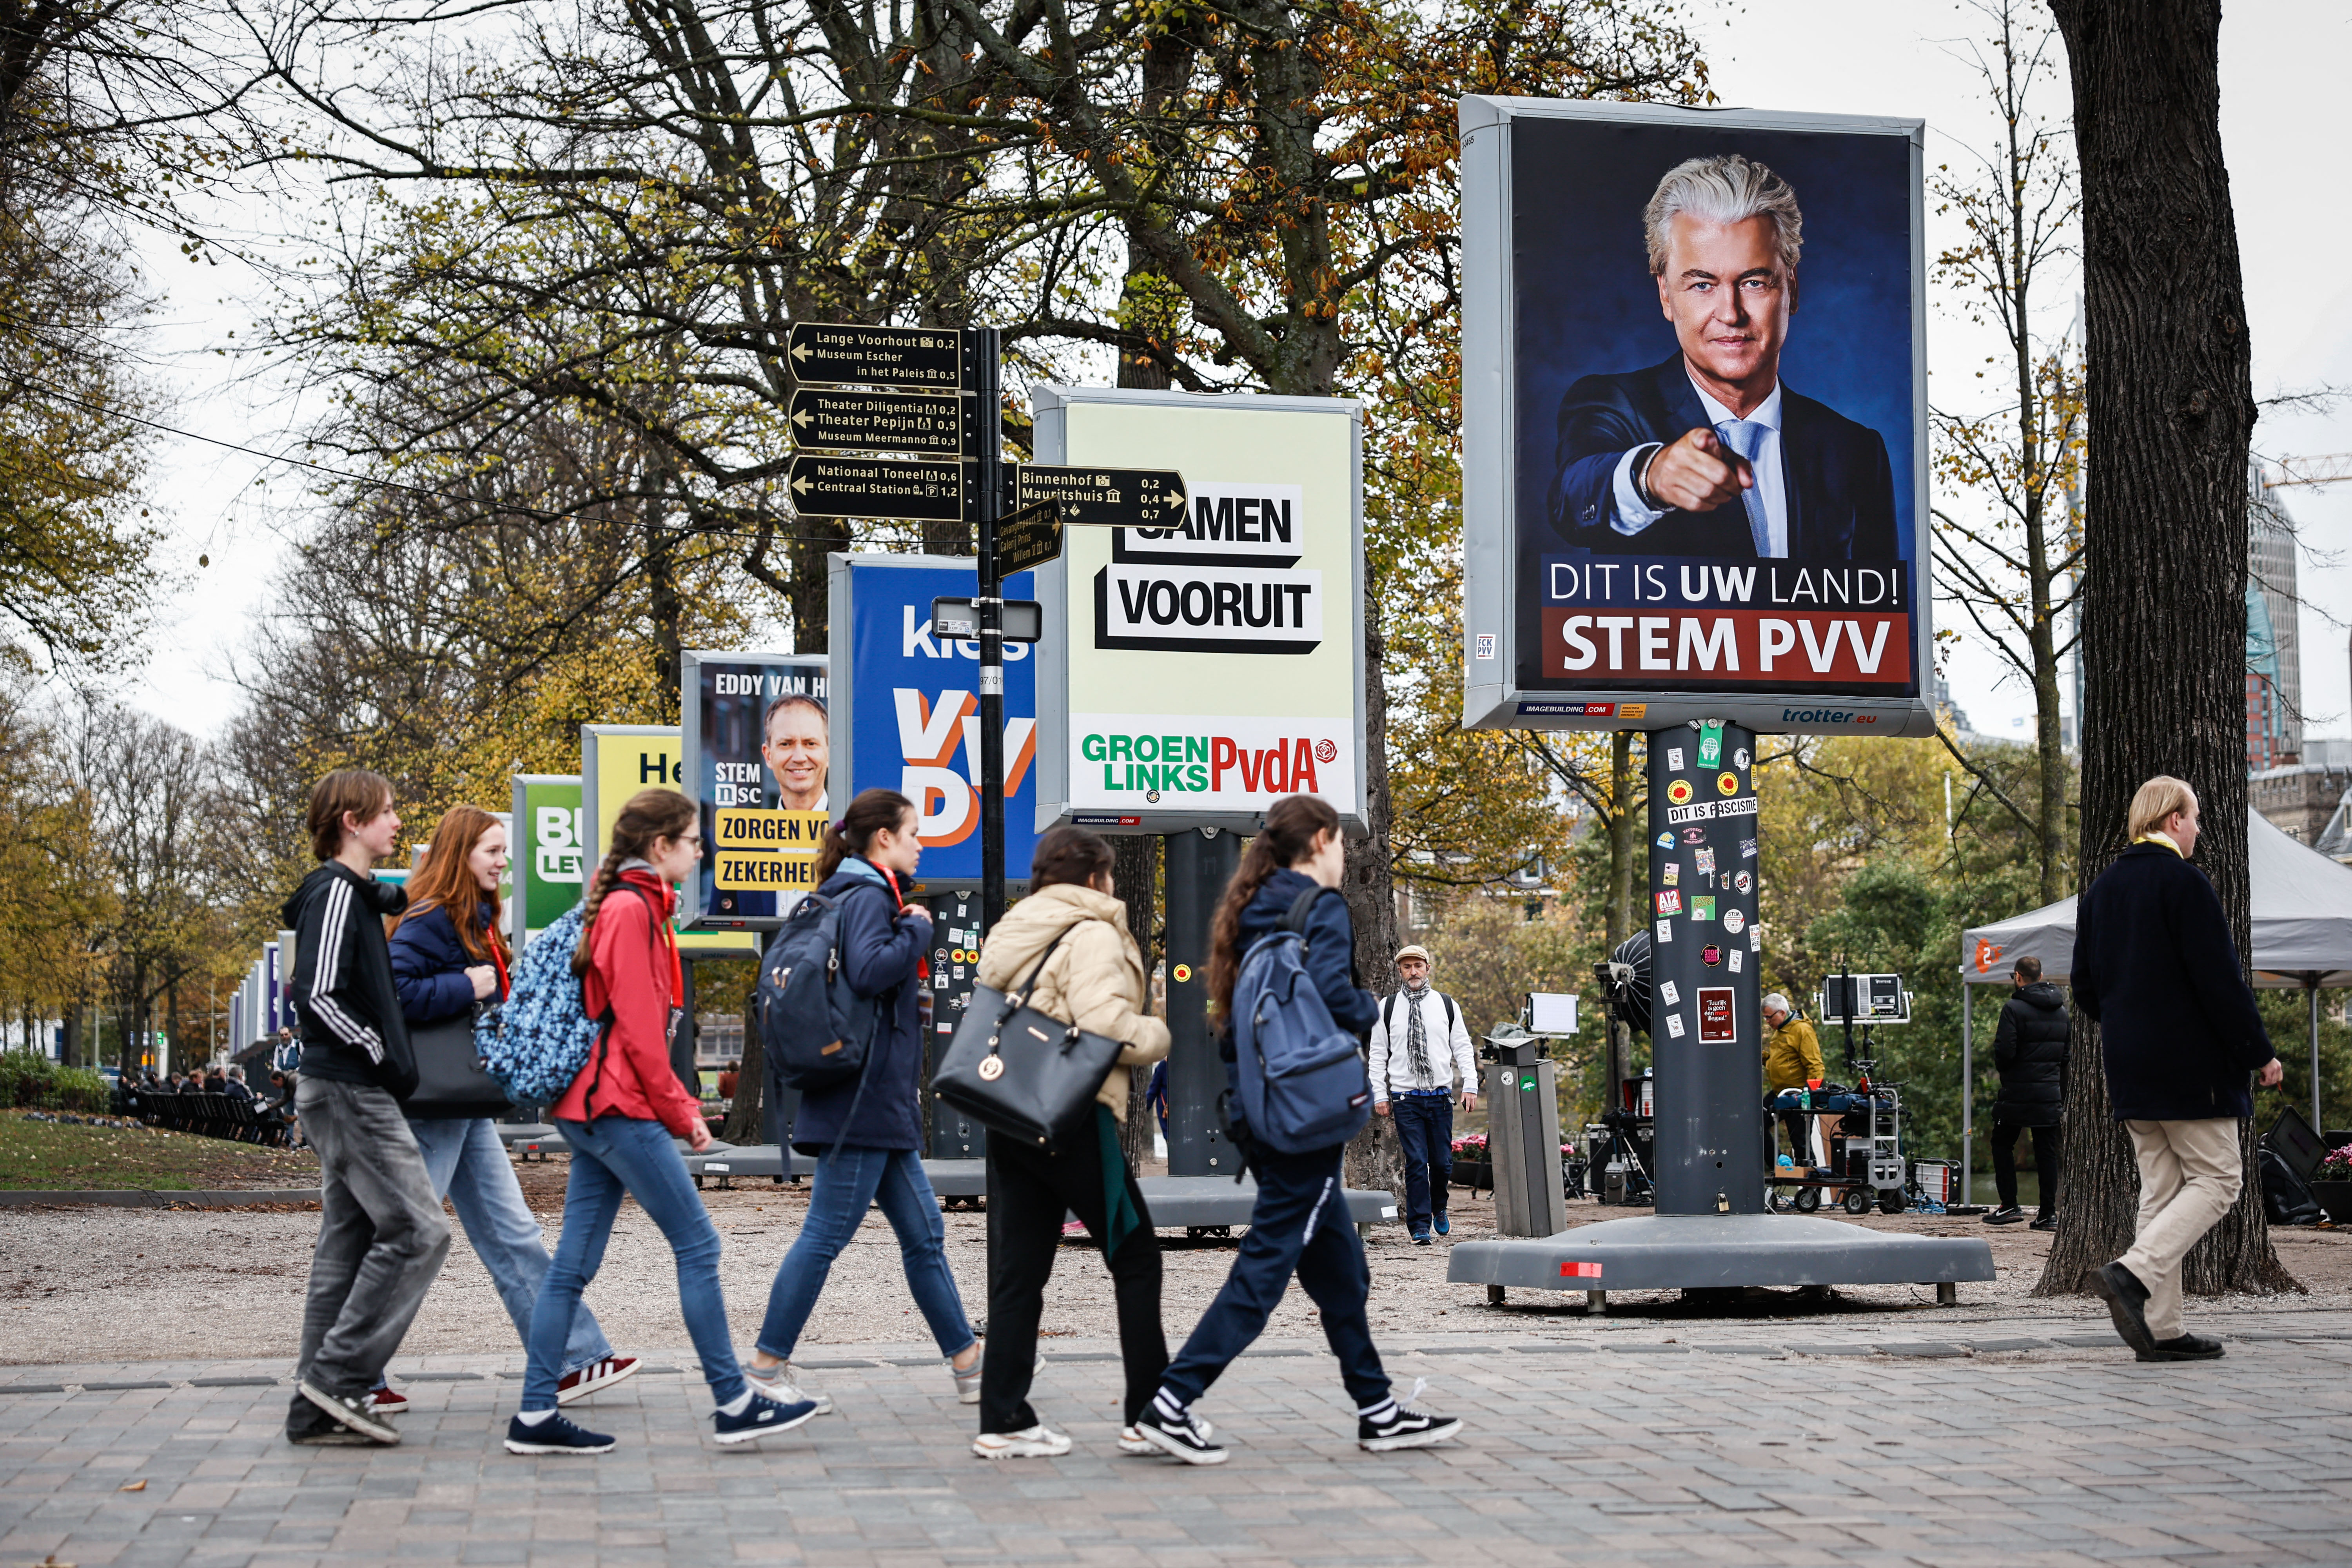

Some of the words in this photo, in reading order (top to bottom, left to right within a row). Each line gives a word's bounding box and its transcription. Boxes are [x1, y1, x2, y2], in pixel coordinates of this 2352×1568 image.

[817, 332, 853, 346] Lange
[858, 334, 917, 347] Voorhout
[937, 339, 955, 350] 0,2
[817, 349, 862, 360] Museum
[866, 351, 902, 361] Escher
[857, 366, 867, 376] in
[871, 367, 889, 376] het
[892, 368, 924, 378] Paleis
[940, 371, 955, 380] 0,5
[817, 399, 862, 411] Theater
[866, 401, 923, 414] Diligentia
[939, 406, 956, 416] 0,2
[817, 413, 869, 426] Theater
[874, 416, 914, 430] Pepijn
[937, 420, 956, 431] 0,9
[818, 431, 862, 441] Museum
[866, 433, 926, 445] Meermanno
[941, 437, 956, 446] 0,9
[818, 465, 878, 478] Nationaal
[882, 468, 924, 480] Toneel
[940, 472, 956, 482] 0,6
[1022, 472, 1092, 486] Binnenhof
[1141, 479, 1160, 490] 0,2
[818, 481, 865, 493] Centraal
[869, 484, 911, 495] Station
[940, 487, 957, 497] 1,2
[1022, 488, 1103, 502] Mauritshuis
[1140, 495, 1159, 505] 0,4
[1142, 510, 1160, 521] 0,7
[1000, 514, 1036, 537] Gevangenpoort
[1000, 537, 1017, 553] Galerij
[1018, 533, 1031, 546] Prins
[1013, 546, 1031, 563] Willem
[1031, 545, 1036, 556] V
[1551, 563, 1619, 600] DIT
[1635, 565, 1666, 601] IS
[1681, 566, 1757, 602] UW
[1771, 568, 1898, 605] LAND!
[1117, 579, 1311, 629] VOORUIT
[1478, 639, 1493, 647] FCK
[1562, 615, 1740, 671] STEM
[1760, 618, 1890, 674] PVV
[715, 673, 764, 696] EDDY
[769, 676, 806, 696] VAN
[980, 676, 1003, 685] 97/01
[1782, 708, 1877, 723] trotter.eu
[715, 762, 760, 783] STEM
[1082, 734, 1209, 763] GROEN
[1212, 737, 1319, 793] PvdA
[1104, 763, 1209, 792] LINKS
[1669, 780, 1691, 795] KERNENERGIE?
[1680, 790, 1692, 804] BEDANKT
[1670, 808, 1689, 821] DIT
[1694, 806, 1705, 818] IS
[1710, 799, 1757, 815] FASCISME
[722, 817, 800, 840] ZORGEN
[1659, 891, 1677, 906] A12
